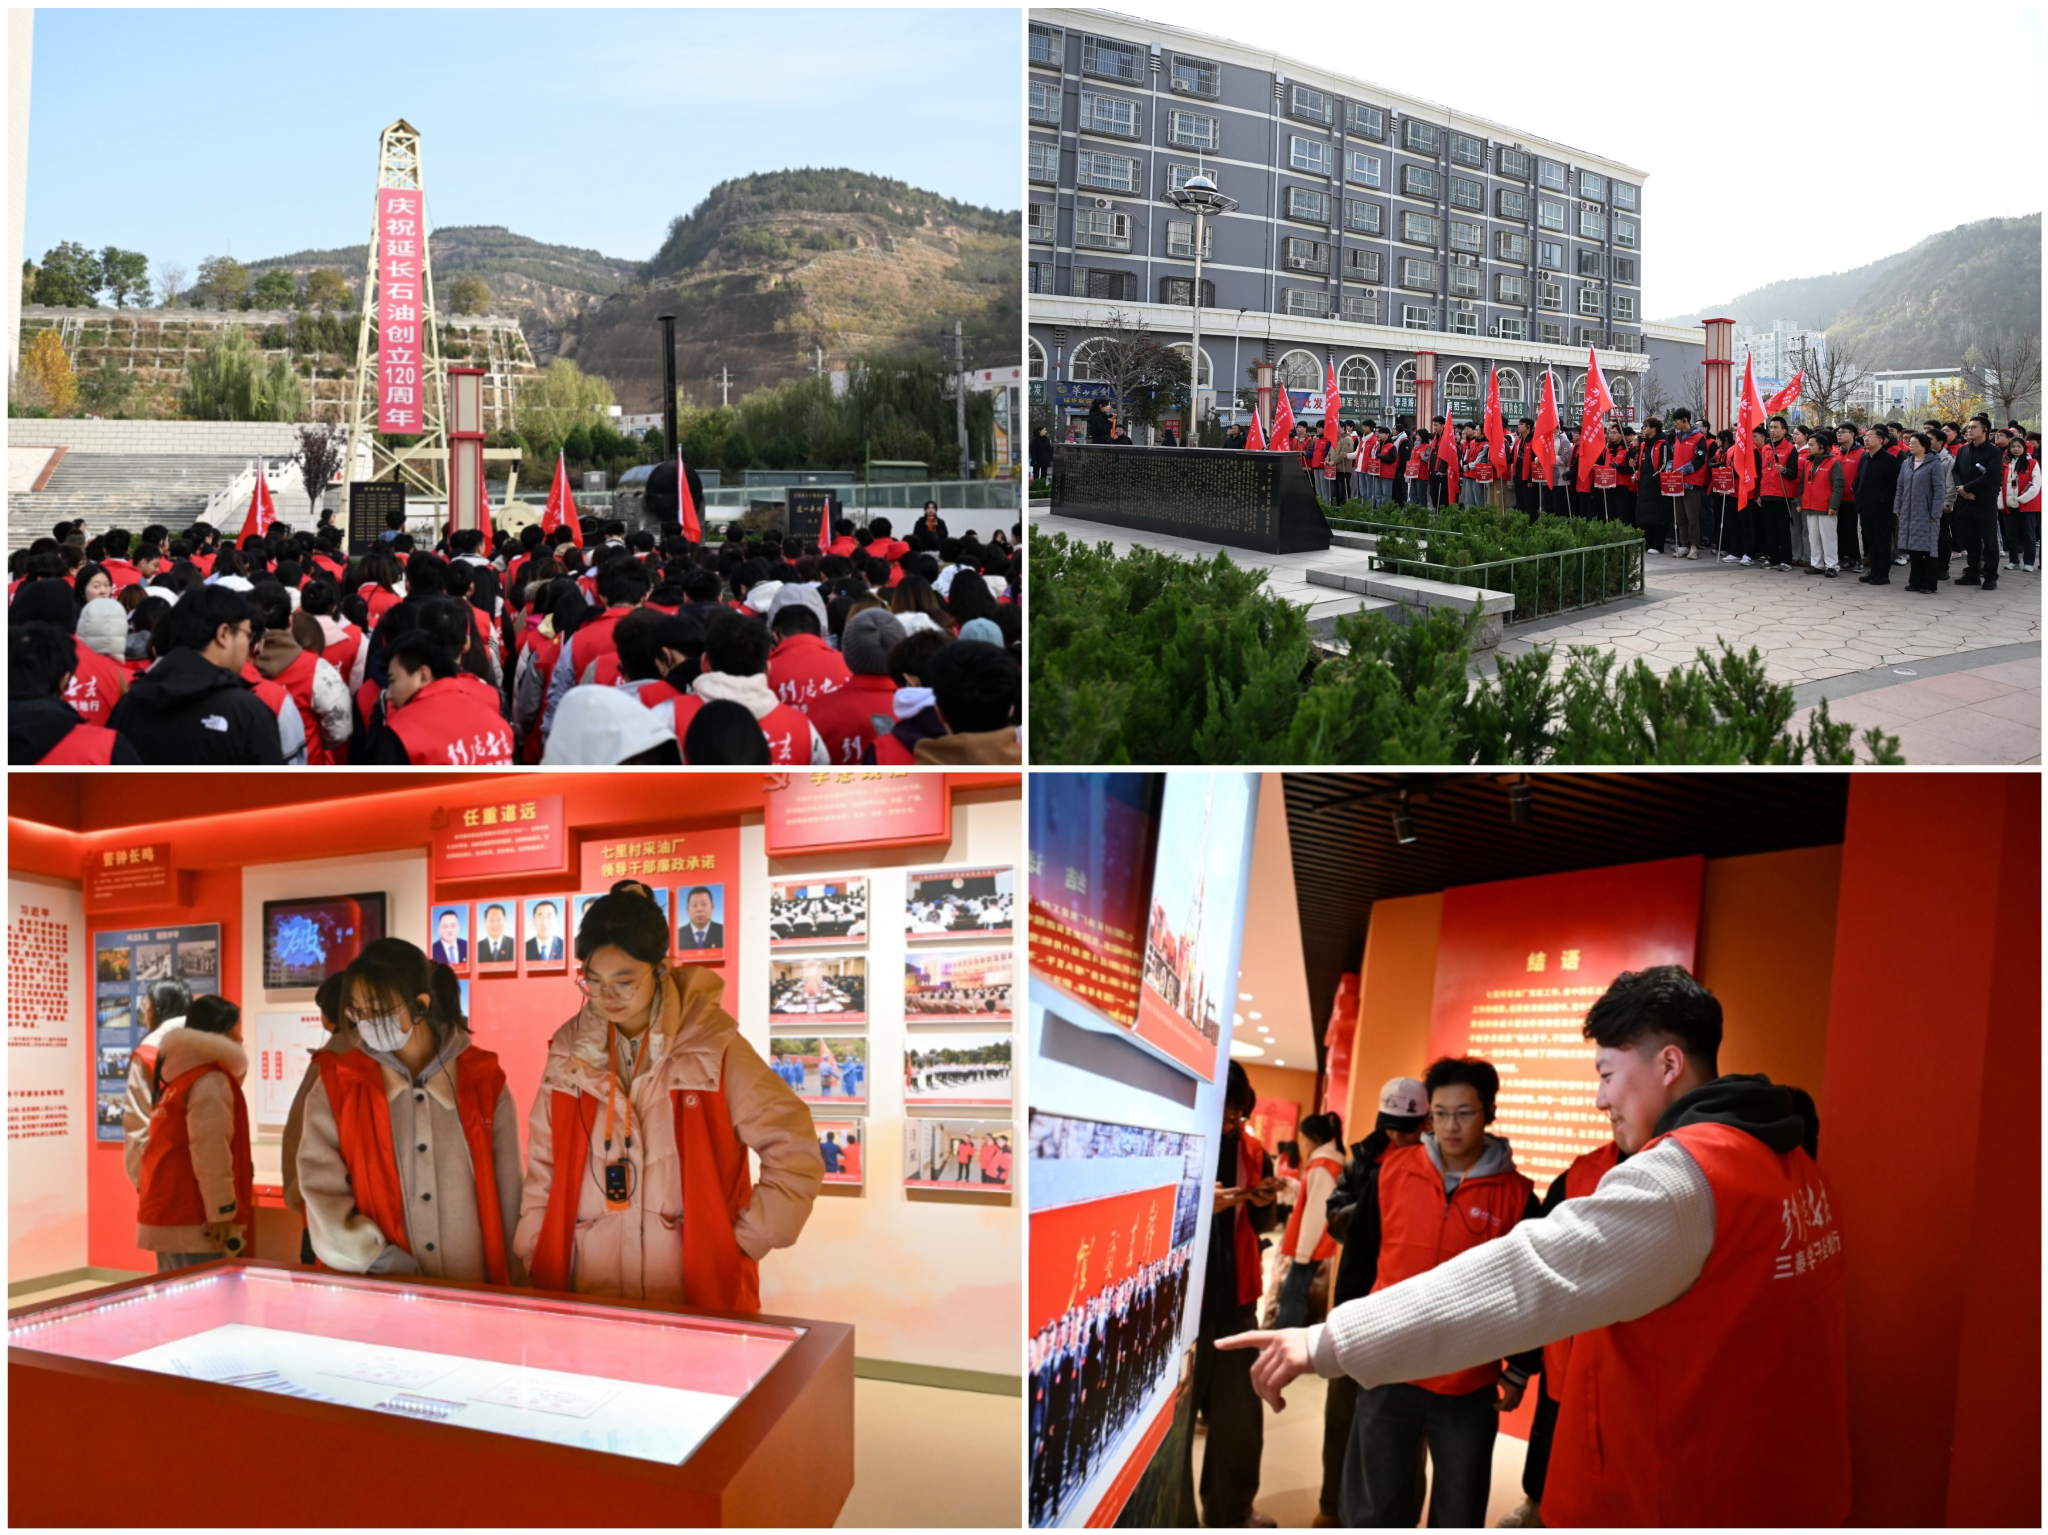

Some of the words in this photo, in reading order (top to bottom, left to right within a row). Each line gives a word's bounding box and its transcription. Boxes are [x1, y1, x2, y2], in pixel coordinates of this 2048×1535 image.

[385, 197, 416, 427] 庆祝延长石油创立120周年
[463, 802, 537, 827] 任重道远
[103, 847, 154, 867] 警钟长鸣
[601, 839, 686, 858] 七里村采油厂
[601, 854, 716, 878] 领导干部廉政承诺
[20, 905, 50, 918] 习近平
[1526, 949, 1581, 972] 结语
